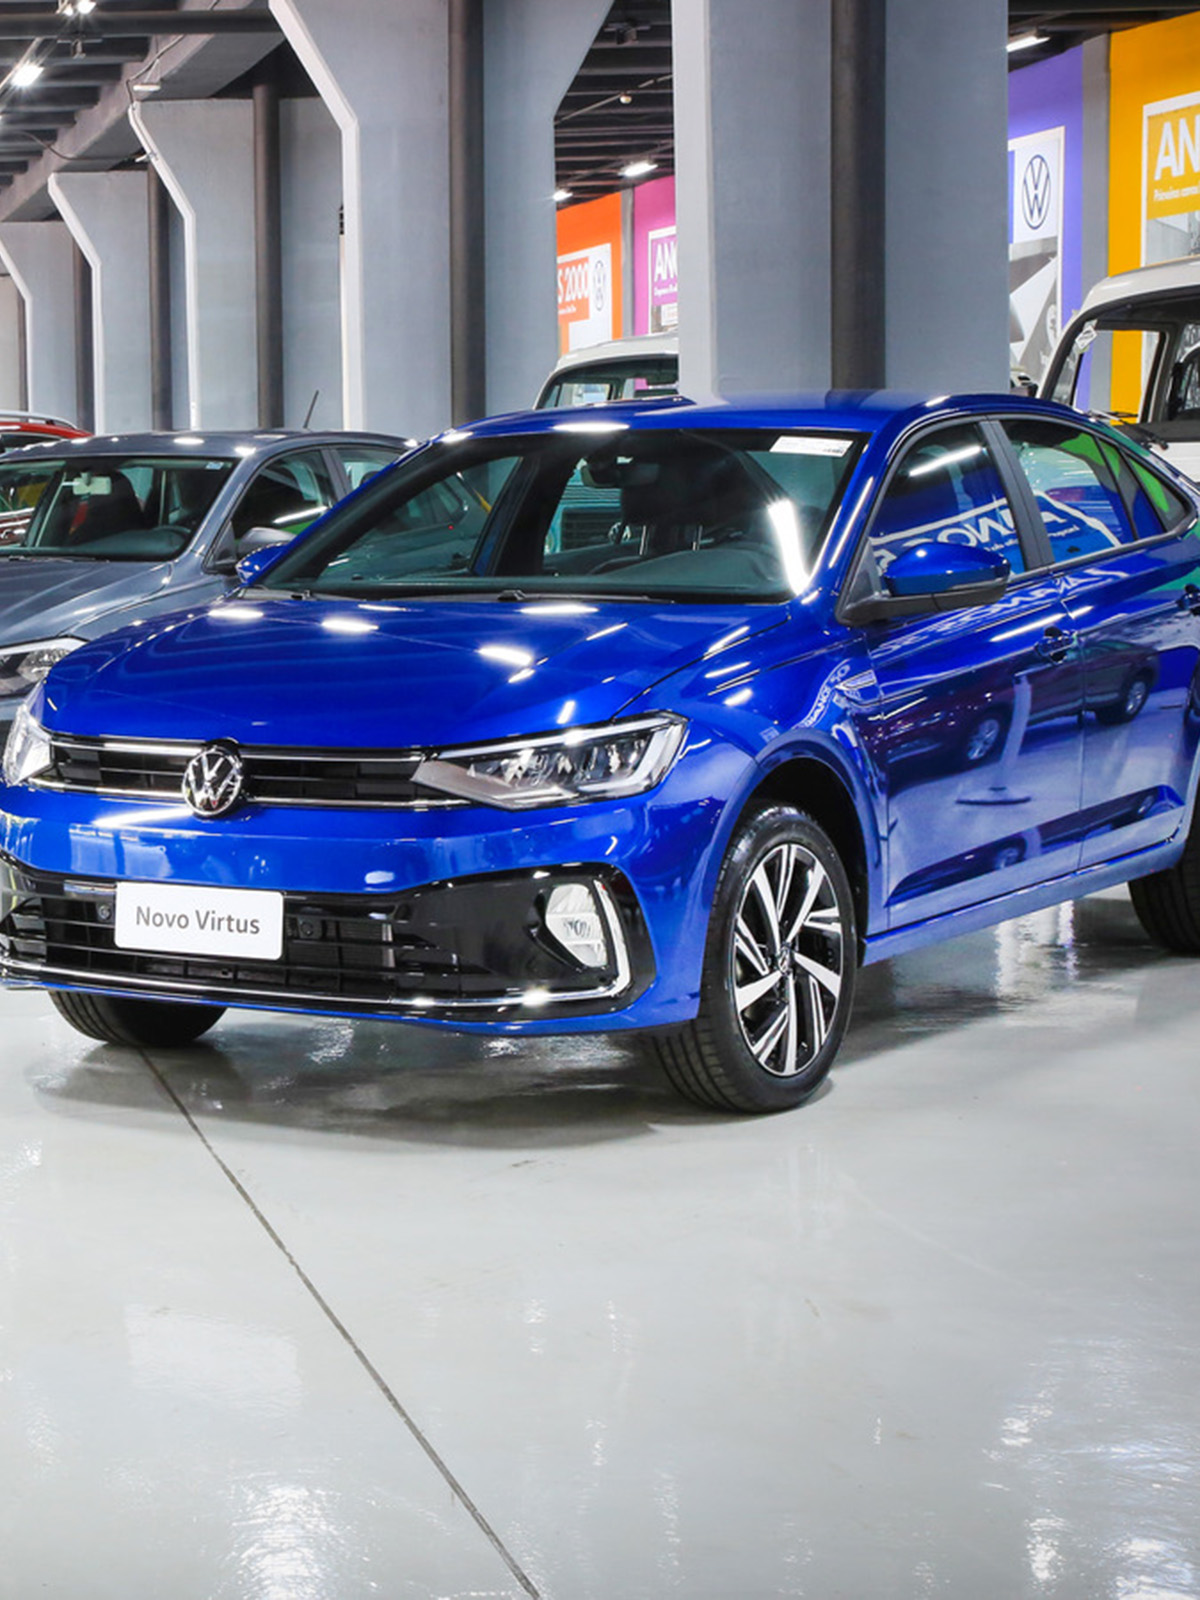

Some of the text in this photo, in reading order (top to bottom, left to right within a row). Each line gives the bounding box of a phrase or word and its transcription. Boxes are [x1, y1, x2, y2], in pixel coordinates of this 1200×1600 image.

[564, 262, 589, 303] 2000
[136, 905, 261, 935] Novo Virtus
